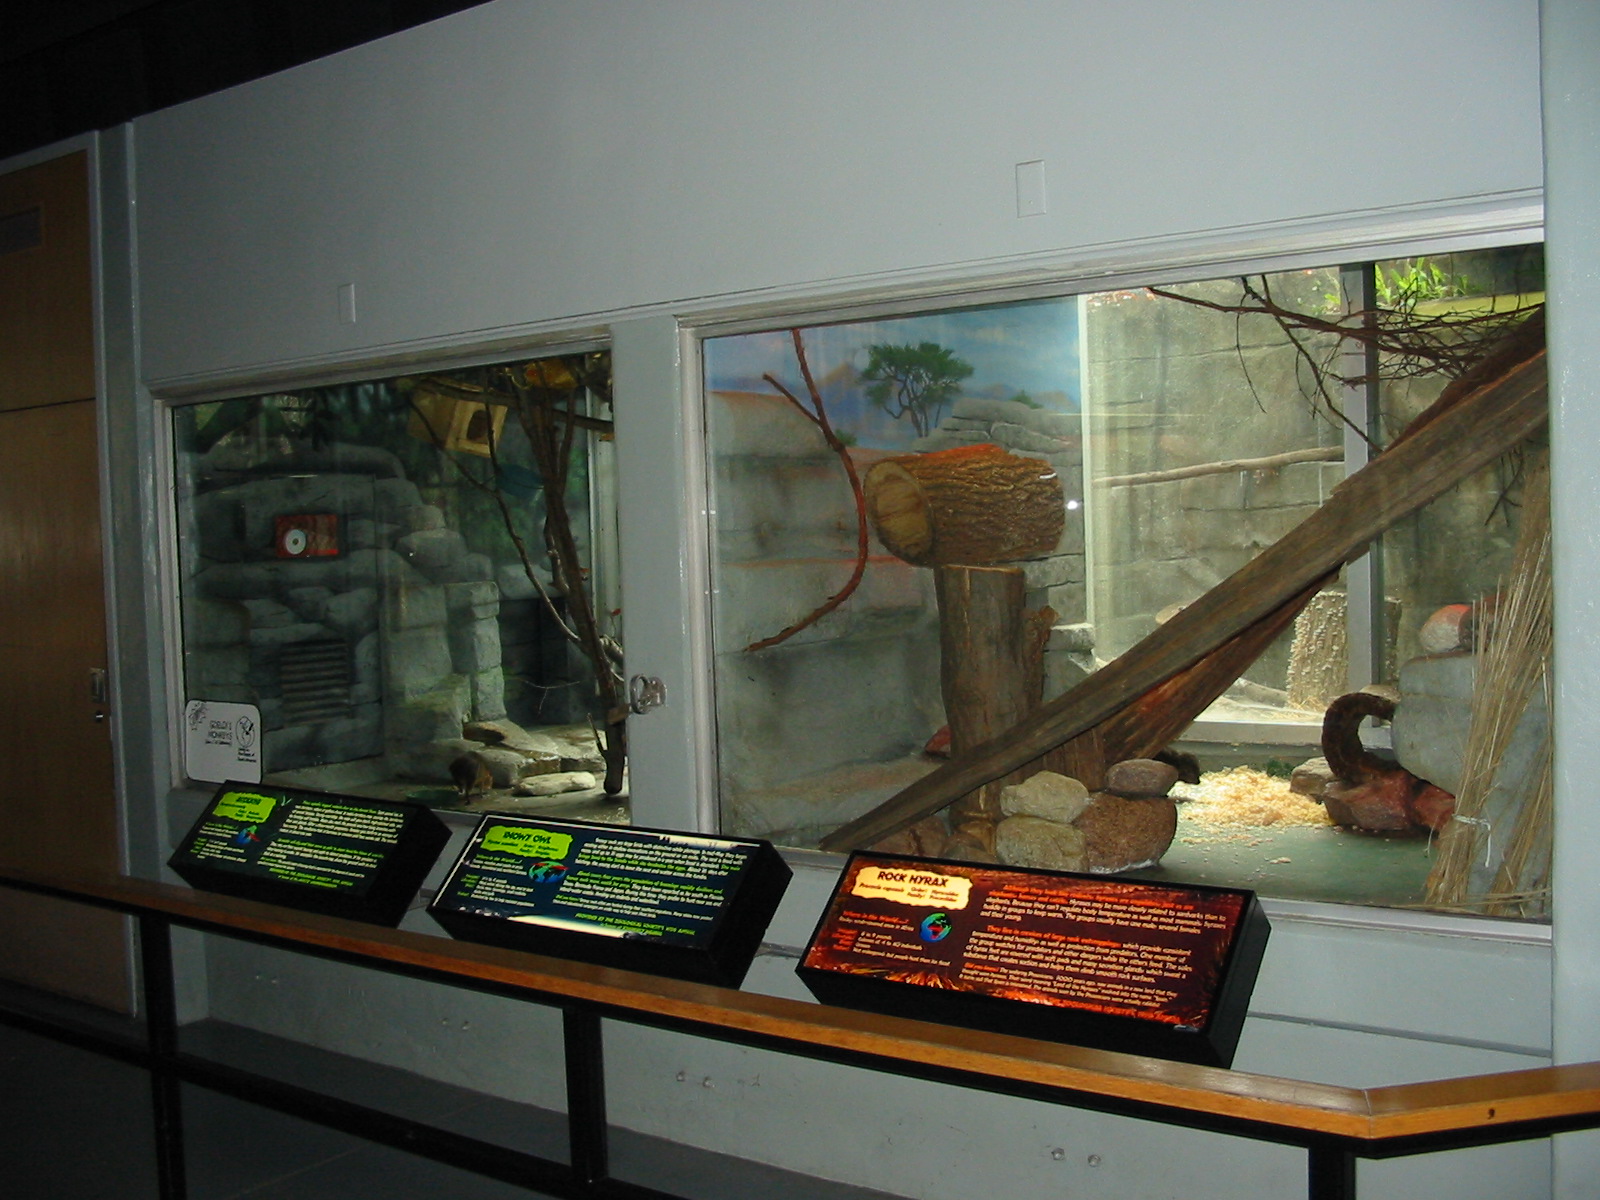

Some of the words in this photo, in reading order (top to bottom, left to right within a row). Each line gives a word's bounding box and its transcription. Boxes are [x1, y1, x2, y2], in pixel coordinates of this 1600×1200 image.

[533, 835, 552, 843] OWL
[878, 871, 907, 882] ROCK
[909, 875, 948, 886] HYRAX
